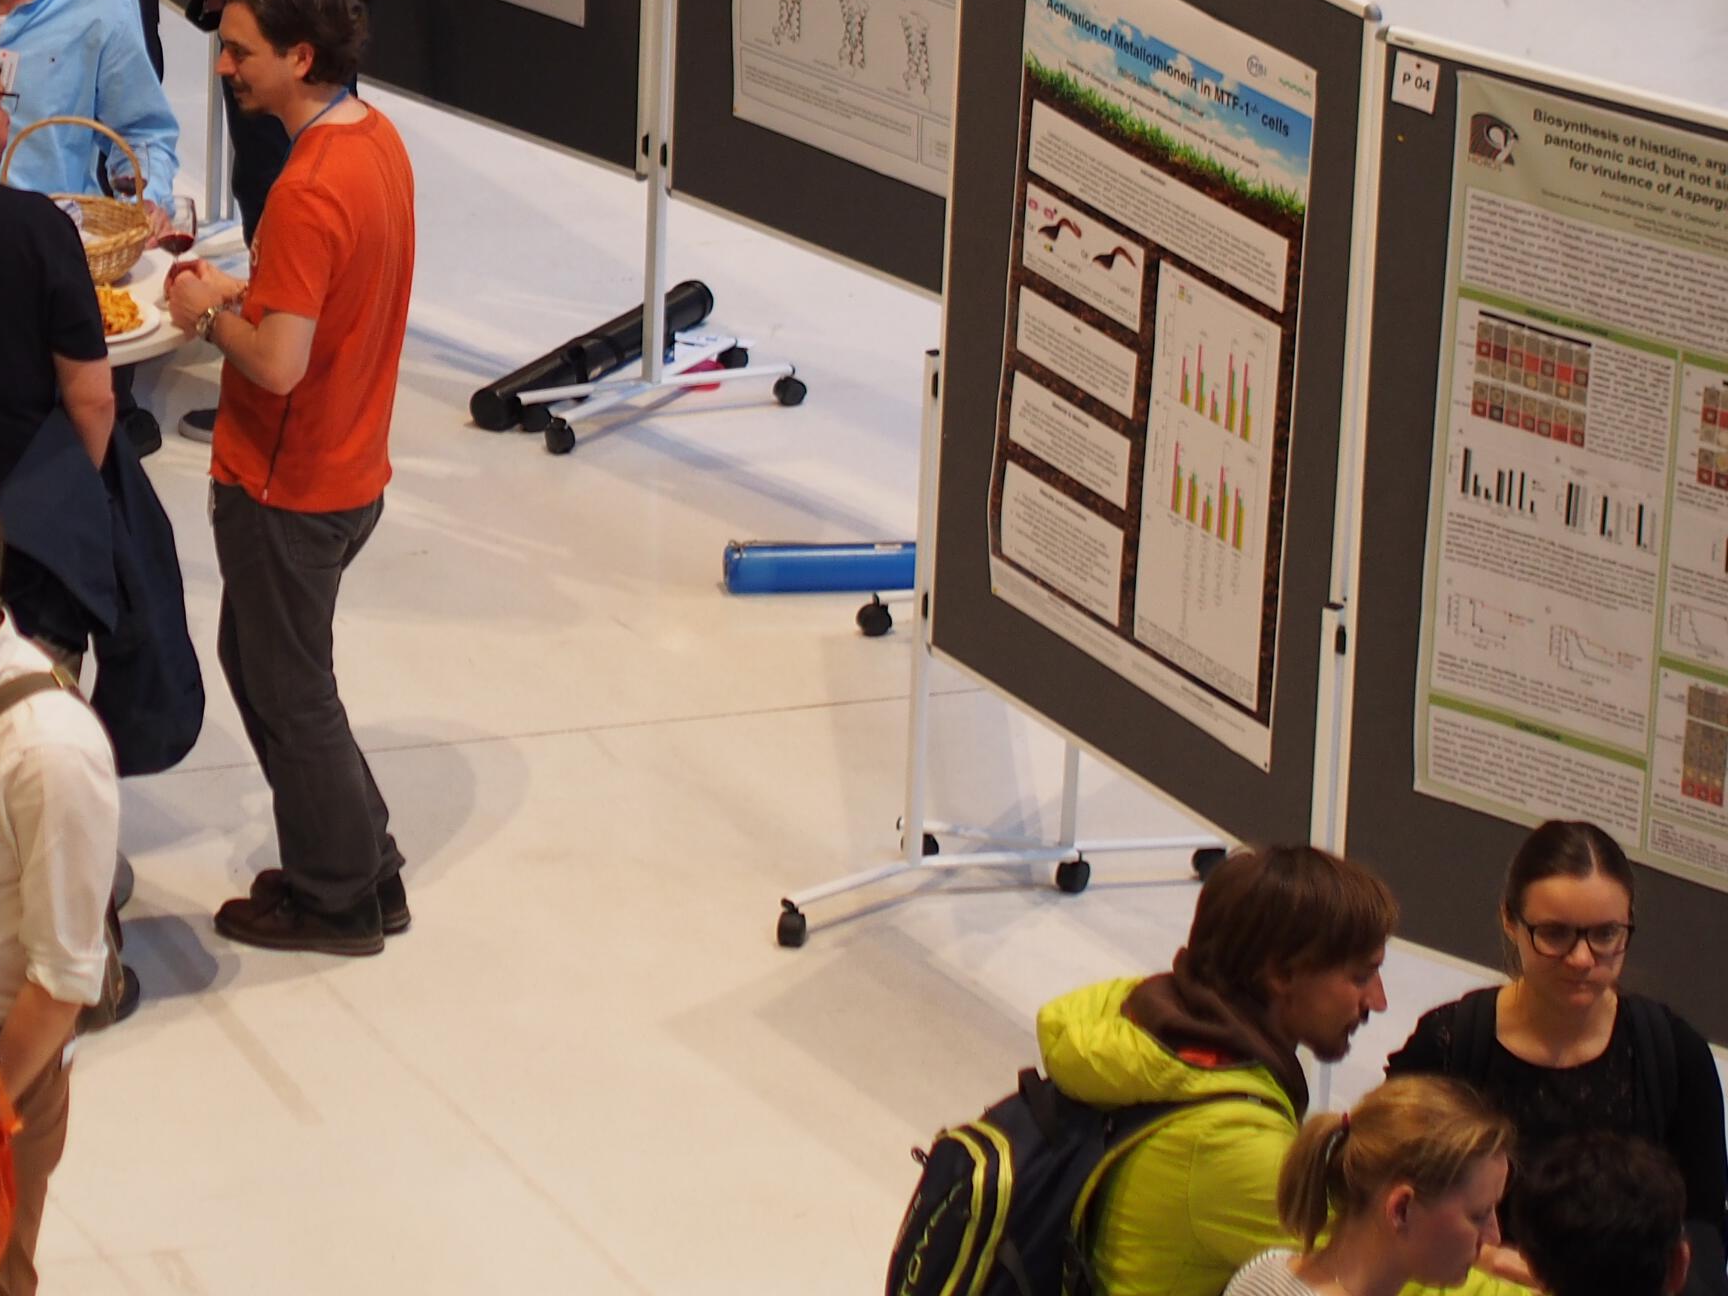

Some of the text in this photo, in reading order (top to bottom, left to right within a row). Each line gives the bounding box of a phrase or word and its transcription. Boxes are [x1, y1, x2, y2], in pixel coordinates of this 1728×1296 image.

[1100, 28, 1112, 44] of
[1114, 31, 1198, 92] Metallothionein
[1200, 81, 1211, 98] in
[1261, 112, 1290, 138] cells
[1402, 71, 1431, 93] P 04
[1532, 108, 1619, 144] Biosynthesis
[1623, 135, 1637, 148] of
[1640, 137, 1701, 167] histidine,
[1544, 133, 1623, 163] pantothenic
[1628, 156, 1659, 174] acid,
[1663, 163, 1686, 181] but
[1689, 170, 1712, 187] not
[1569, 156, 1589, 172] for
[1591, 163, 1653, 190] virulence
[1657, 181, 1672, 195] of
